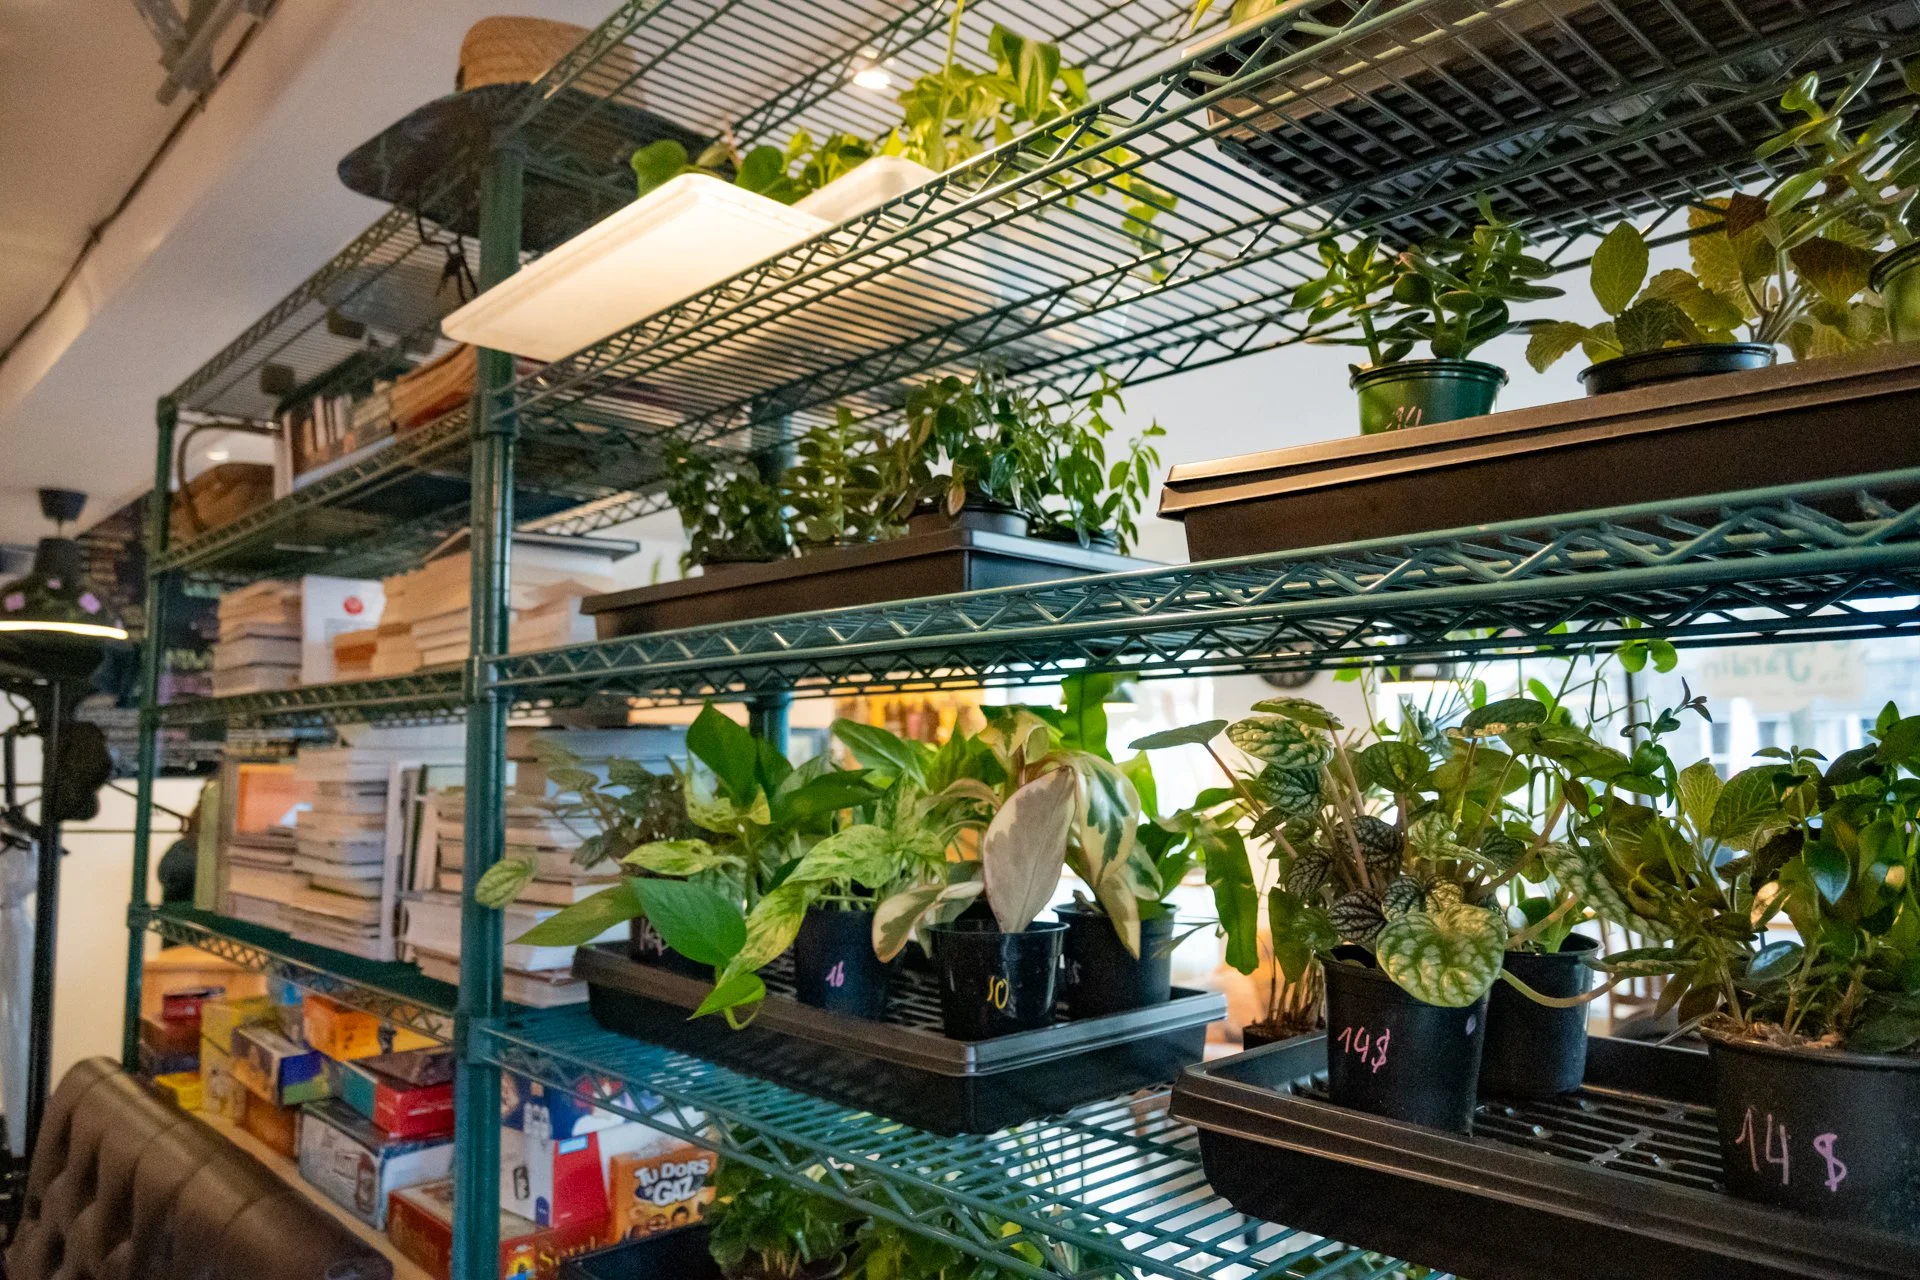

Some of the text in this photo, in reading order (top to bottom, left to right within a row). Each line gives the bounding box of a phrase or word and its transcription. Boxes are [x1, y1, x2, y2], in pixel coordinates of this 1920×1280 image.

[987, 975, 1009, 1009] 10
[1337, 1026, 1391, 1073] 14$
[1735, 1107, 1847, 1192] 14 $
[635, 1160, 709, 1186] TU DORS
[653, 1176, 697, 1205] GAZ
